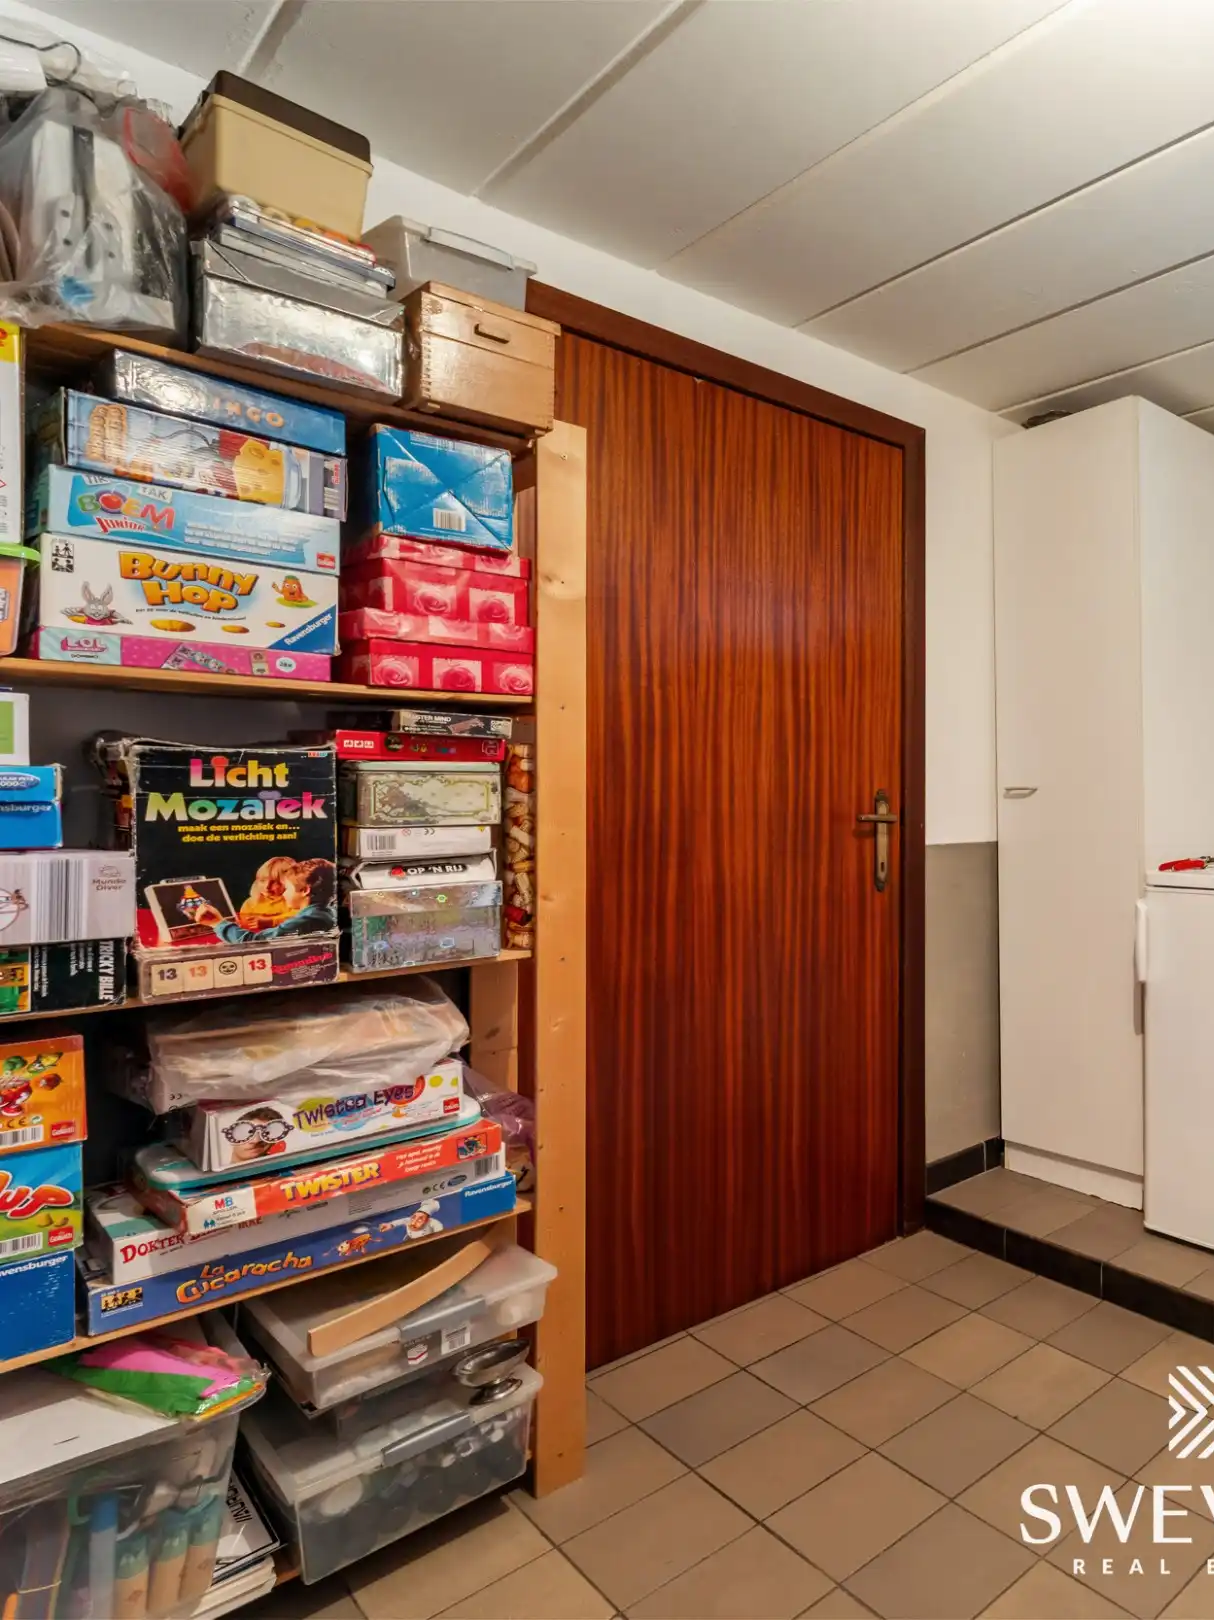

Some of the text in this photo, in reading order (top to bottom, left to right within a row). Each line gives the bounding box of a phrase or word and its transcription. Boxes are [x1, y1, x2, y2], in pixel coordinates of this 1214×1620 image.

[206, 397, 285, 428] INGO
[142, 486, 168, 500] TAK
[77, 488, 176, 531] BOEM
[118, 550, 259, 597] Bunny
[142, 580, 239, 613] Hop
[284, 611, 334, 647] Ravensburger
[189, 755, 289, 788] Licht
[144, 790, 328, 822] Mozaïek
[177, 823, 208, 832] maak
[209, 824, 230, 832] een
[181, 832, 205, 843] doe
[206, 832, 221, 842] de
[222, 831, 275, 843] verlichting
[407, 867, 426, 876] OP
[445, 864, 464, 873] RIJ
[98, 940, 115, 974] TRICKY
[157, 958, 267, 981] 13 13 13
[373, 1083, 415, 1106] Eyes
[280, 1161, 382, 1201] TWISTER
[464, 1179, 514, 1198] Ravensburger
[213, 1195, 235, 1210] MB
[200, 1263, 225, 1280] La
